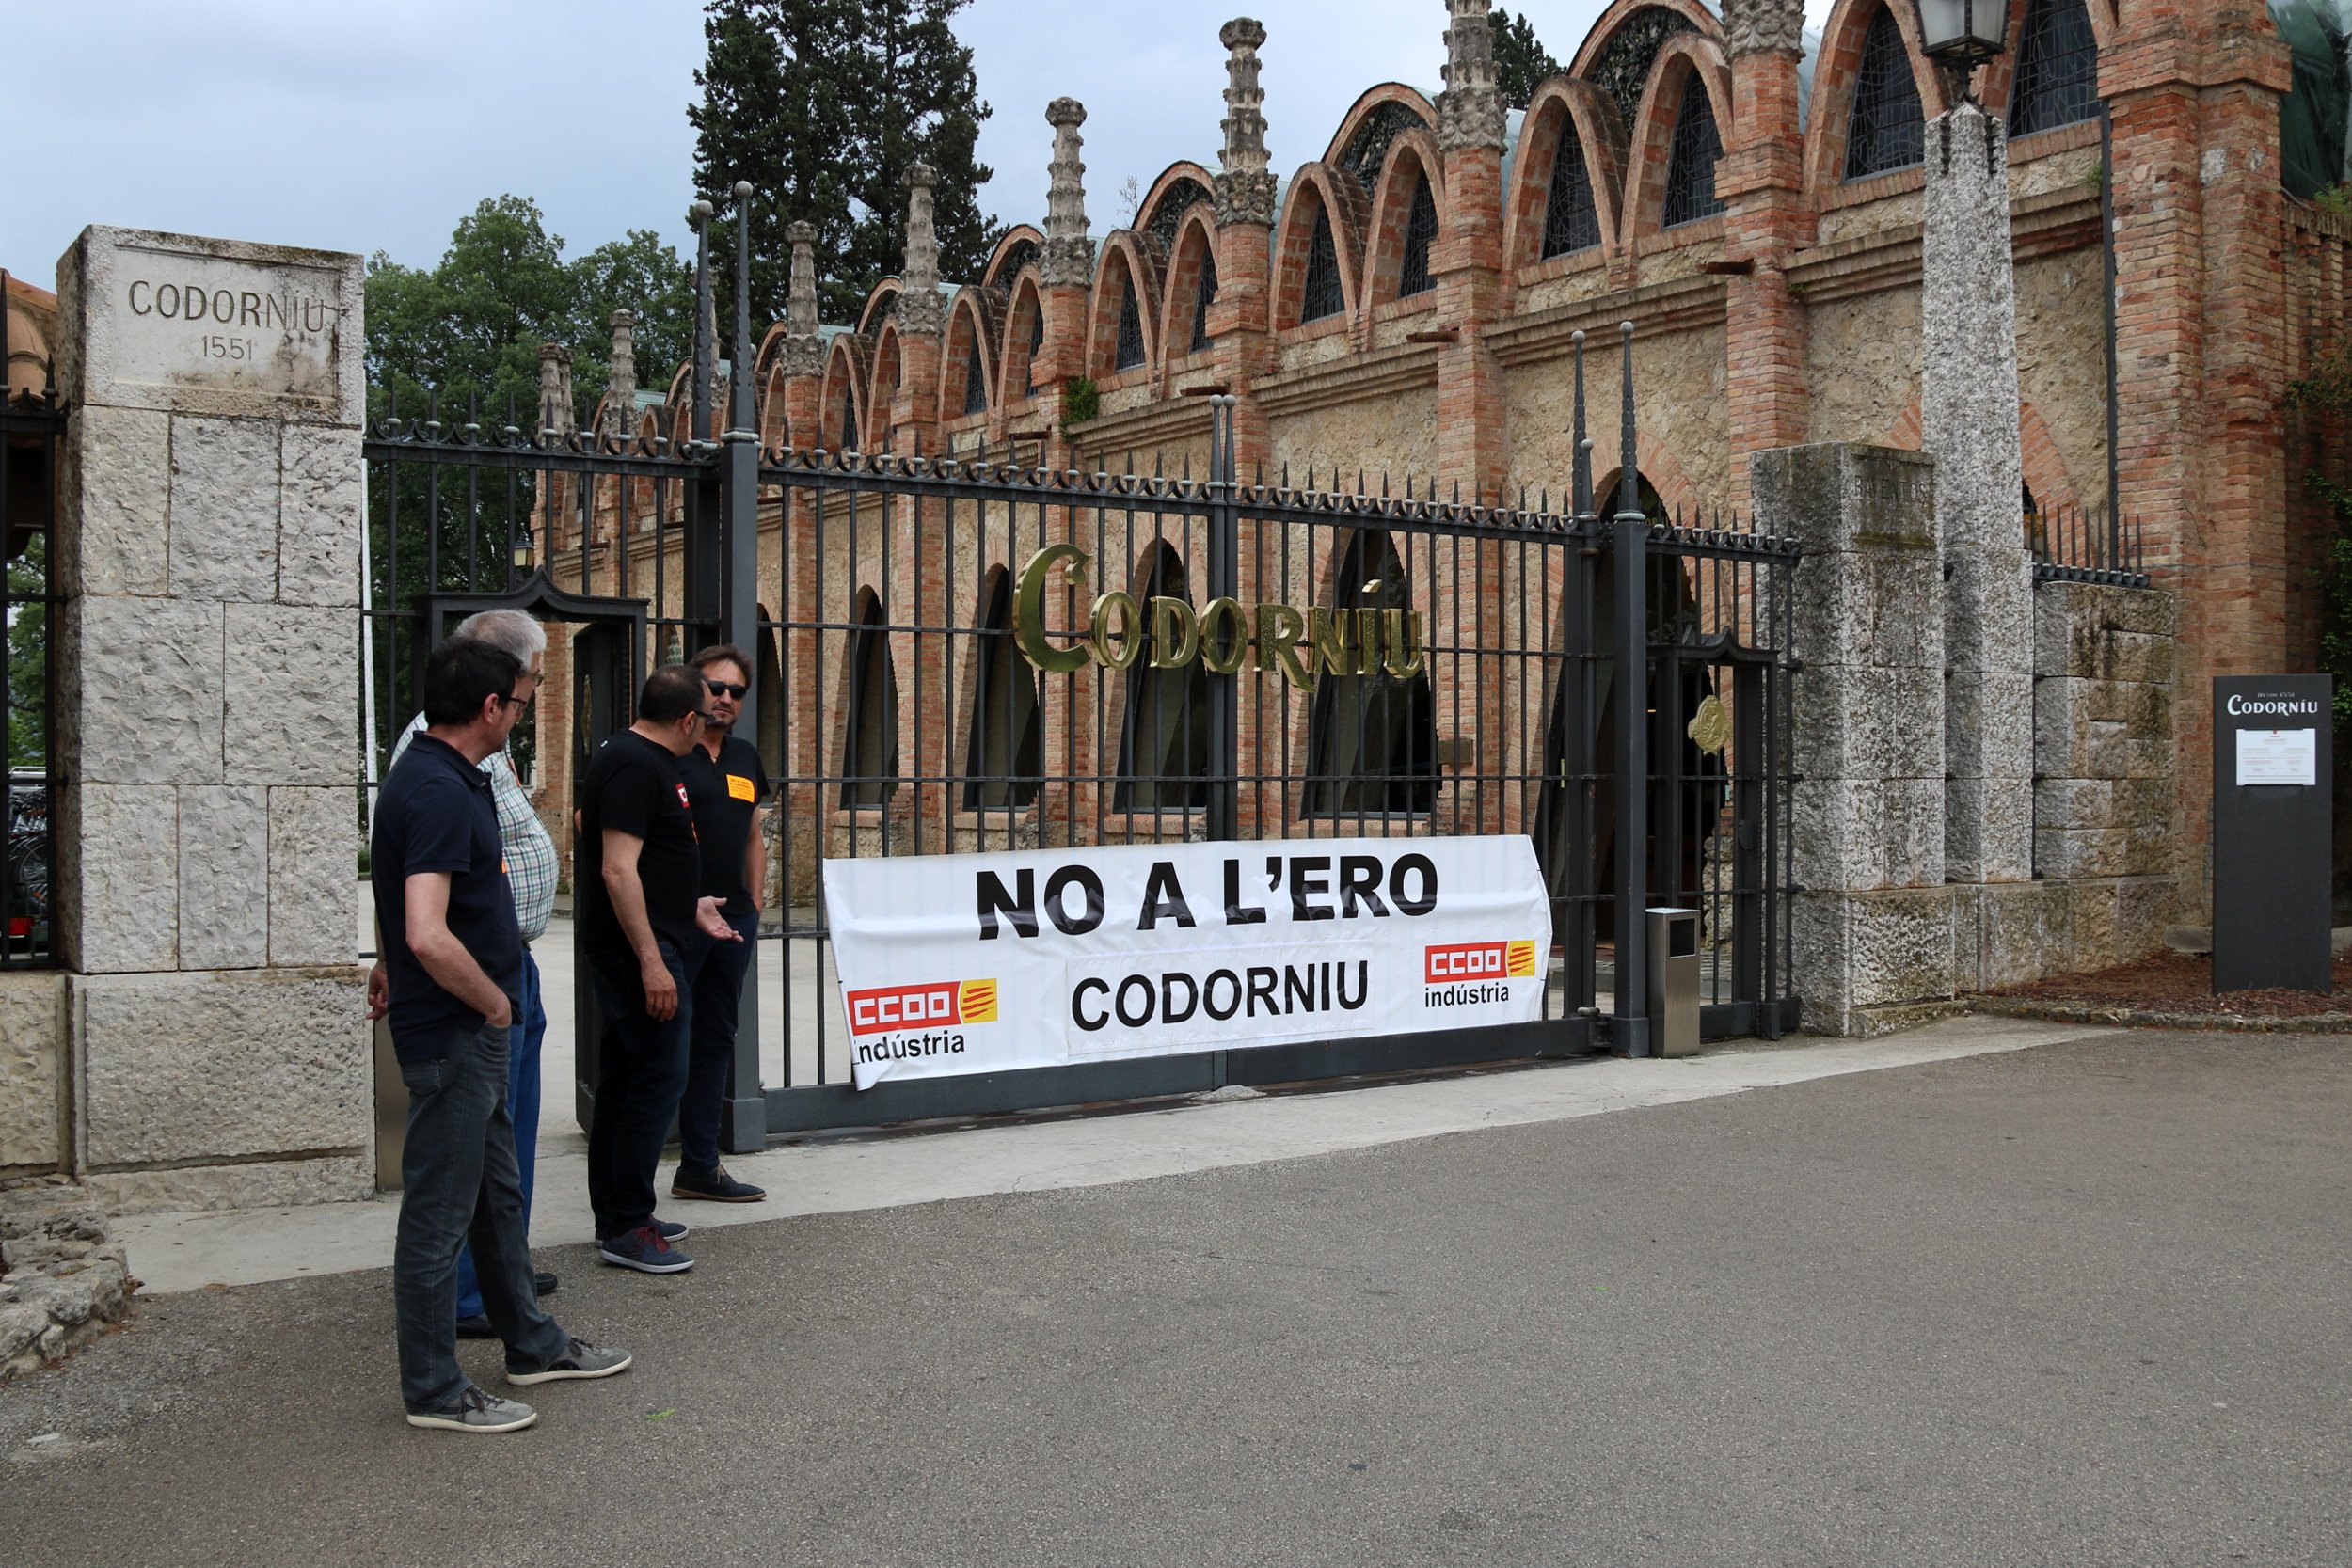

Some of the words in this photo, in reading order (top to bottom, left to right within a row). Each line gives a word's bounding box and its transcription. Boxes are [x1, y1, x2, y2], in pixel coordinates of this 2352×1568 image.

[128, 280, 325, 333] CODORNIU
[201, 335, 253, 361] 1551
[975, 863, 1106, 941] NO
[1136, 861, 1196, 931] A
[1223, 852, 1439, 927] L'ERO
[1430, 949, 1502, 976] CCOO
[853, 990, 950, 1026] CCOO
[1070, 959, 1370, 1032] CODORNIU
[1425, 982, 1509, 1008] indústria
[854, 1030, 965, 1065] ndústria
